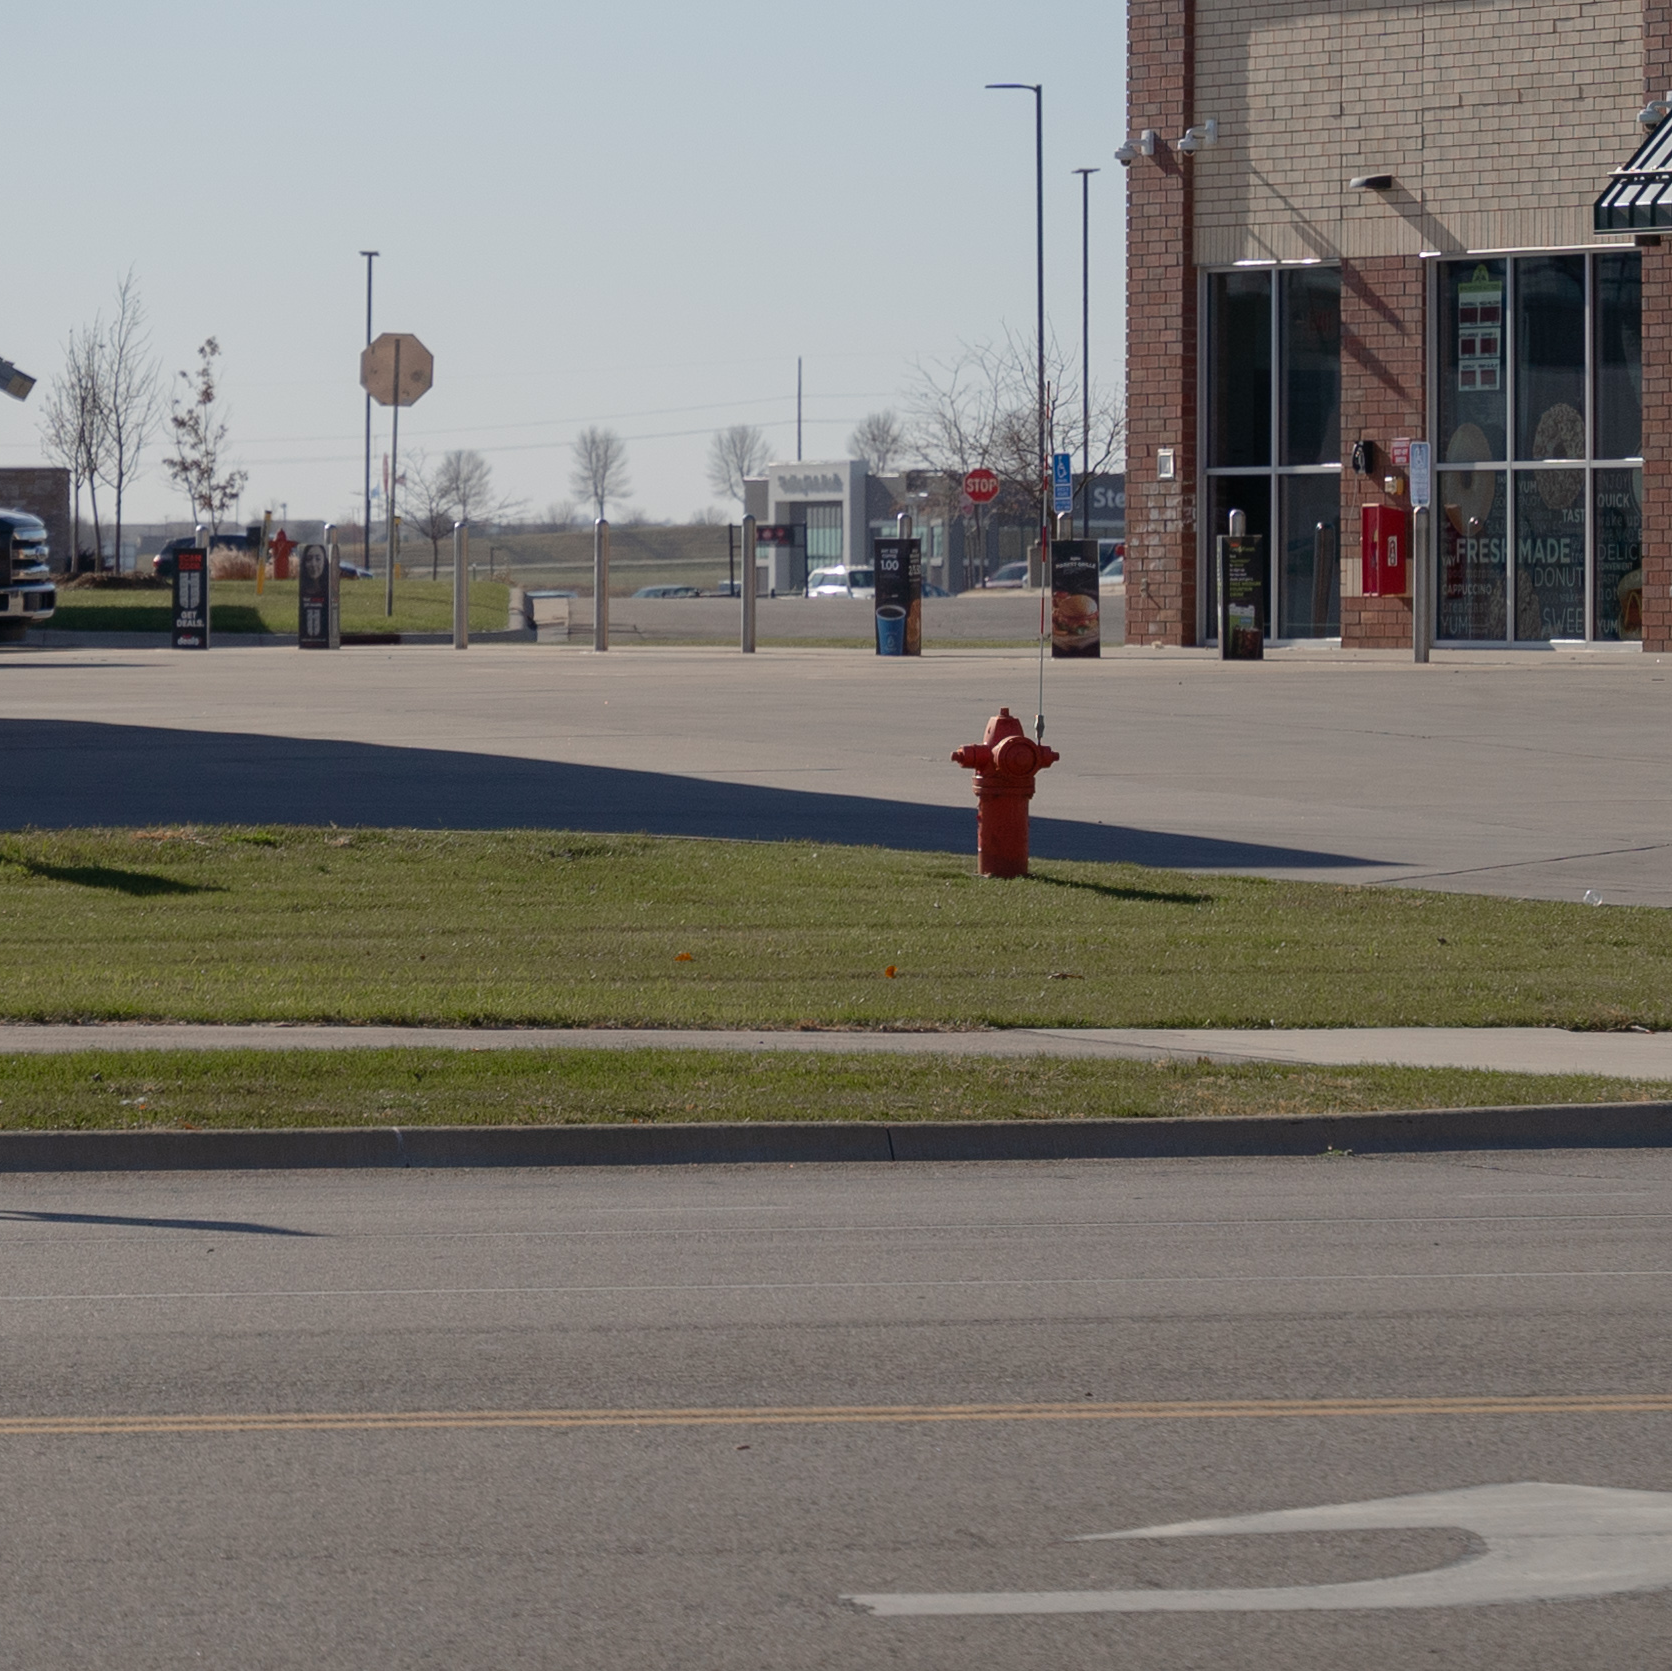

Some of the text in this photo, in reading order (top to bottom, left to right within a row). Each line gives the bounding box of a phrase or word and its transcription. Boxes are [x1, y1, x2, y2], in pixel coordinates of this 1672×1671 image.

[966, 479, 997, 493] STOP
[1518, 481, 1537, 493] YUM
[1597, 493, 1629, 507] QUICK
[1518, 538, 1571, 564] MADE
[1441, 584, 1492, 596] CAPPUCCINO
[181, 611, 197, 619] GET
